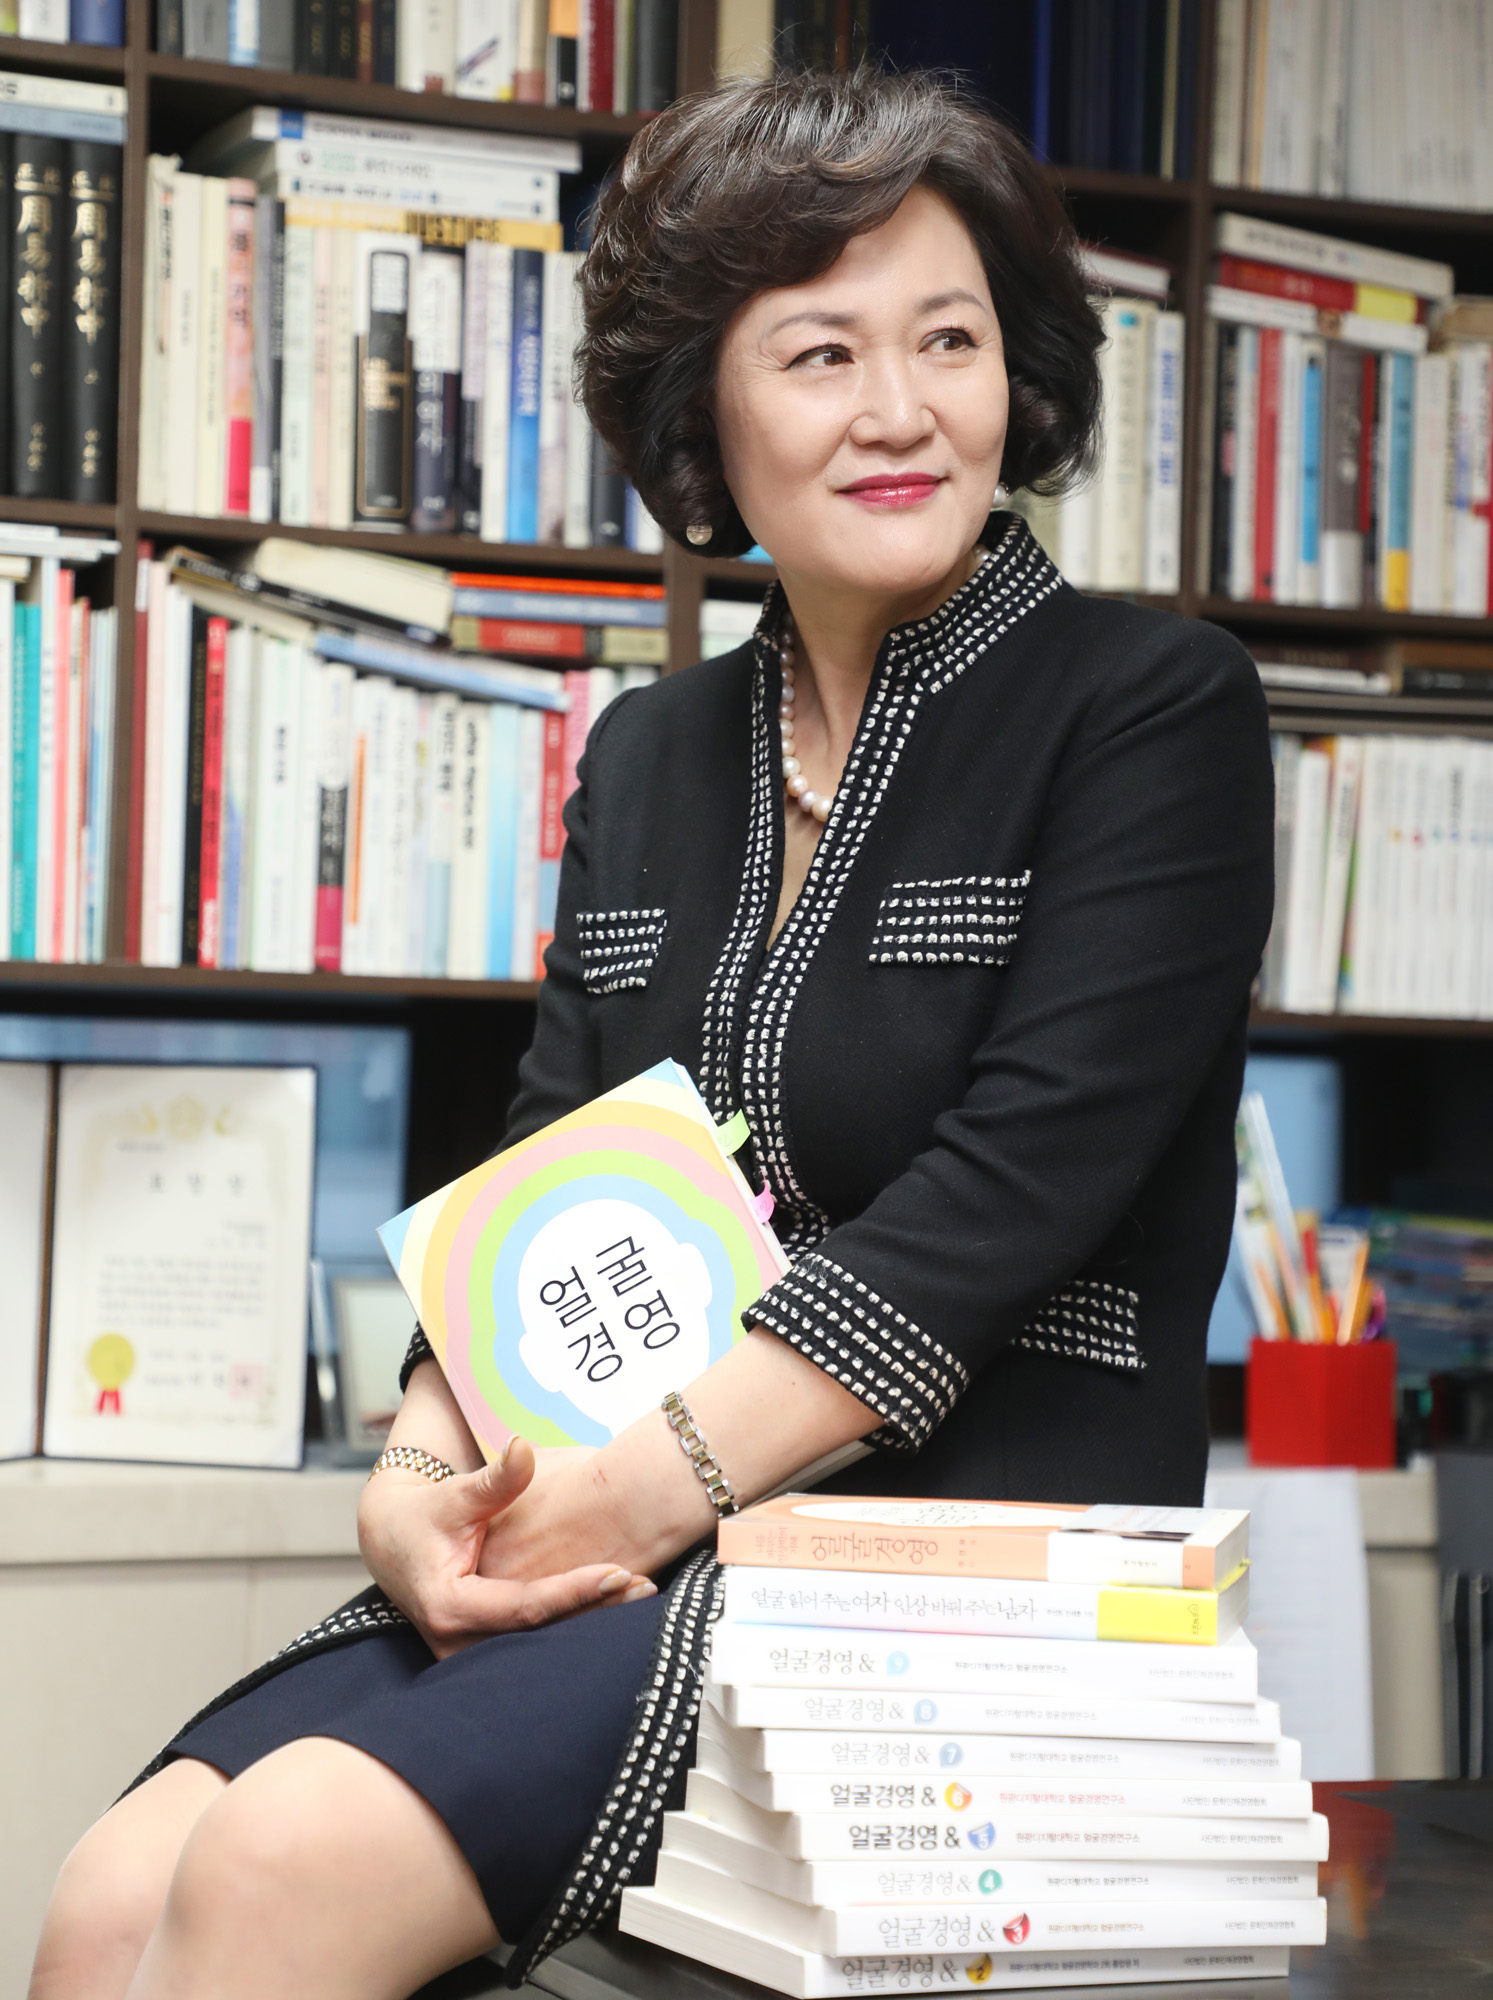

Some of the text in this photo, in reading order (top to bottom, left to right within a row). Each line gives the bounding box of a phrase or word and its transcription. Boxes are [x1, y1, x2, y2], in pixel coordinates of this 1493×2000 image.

[539, 1236, 653, 1329] 얼굴
[567, 1289, 681, 1383] 경영
[810, 1531, 939, 1565] 얼굴경영
[751, 1587, 787, 1610] 얼굴
[789, 1591, 818, 1610] 읽어
[852, 1590, 891, 1614] 여자
[894, 1594, 930, 1617] 인상
[997, 1597, 1038, 1622] 남자
[770, 1648, 853, 1675] 얼굴경영
[805, 1697, 884, 1722] 얼굴경영
[832, 1742, 910, 1767] 얼굴경영
[830, 1784, 915, 1808] 얼굴경영
[849, 1824, 938, 1851] 얼굴경영
[878, 1871, 954, 1896] 얼굴경영
[879, 1915, 972, 1949] 얼굴경영
[841, 1955, 934, 1991] 얼굴경영
